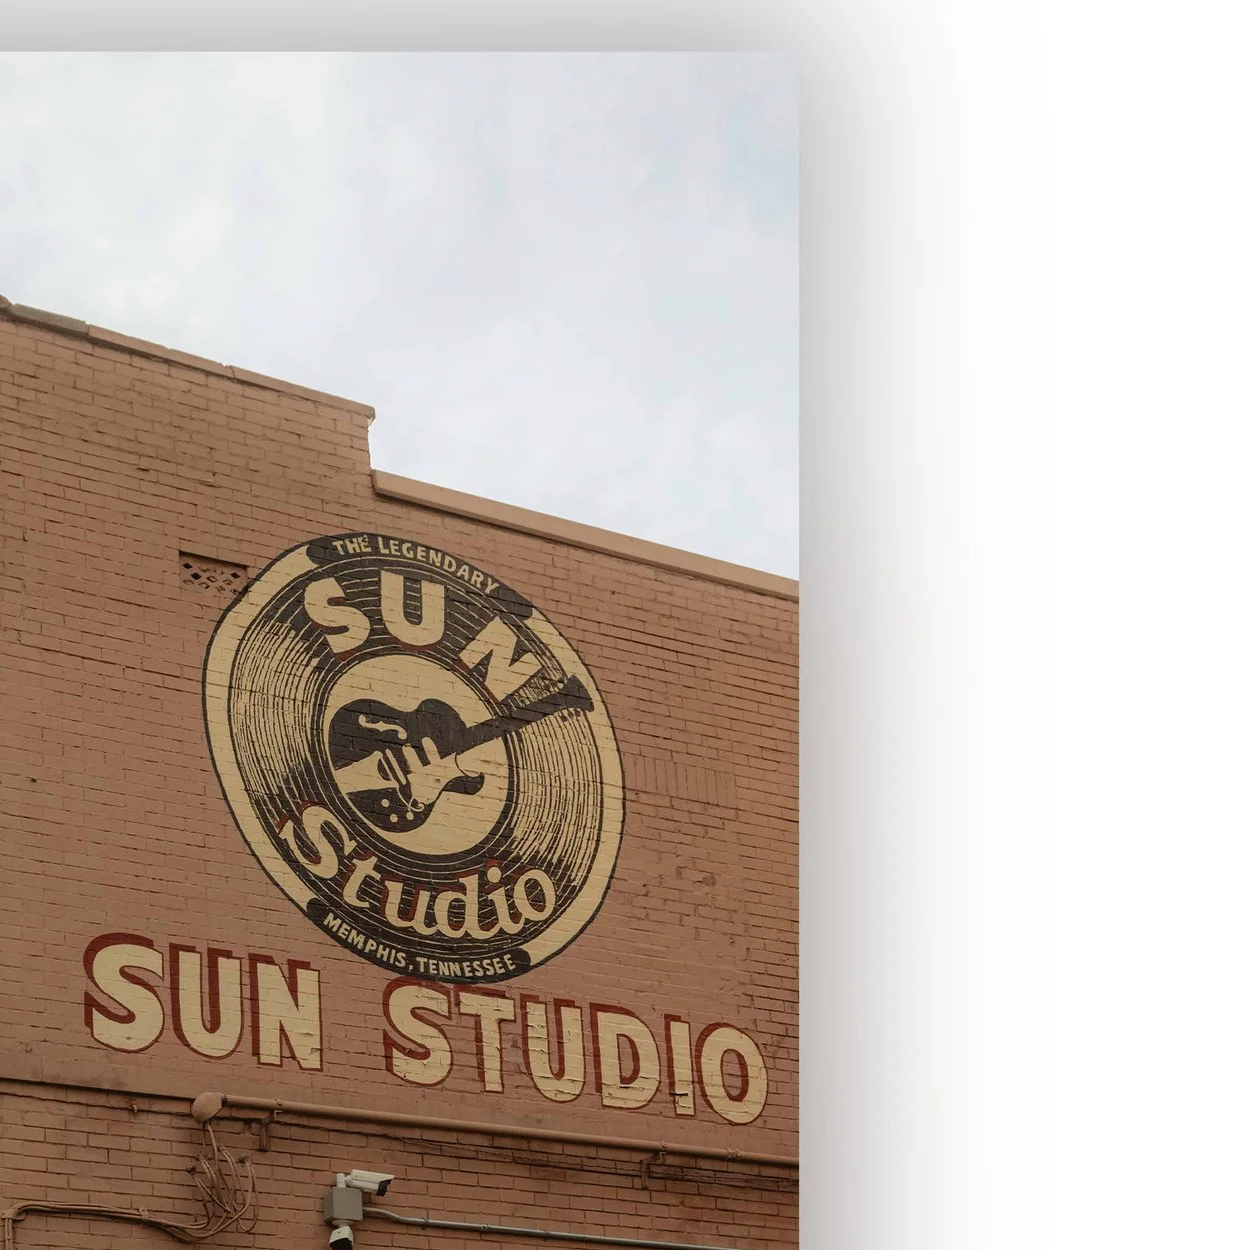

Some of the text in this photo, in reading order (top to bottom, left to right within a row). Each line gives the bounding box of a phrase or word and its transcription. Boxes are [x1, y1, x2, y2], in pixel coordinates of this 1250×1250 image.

[332, 534, 500, 594] THE LEGENDARY
[304, 570, 544, 702] SUN
[280, 802, 557, 939] Studio
[83, 933, 769, 1125] SUN STUDIO
[415, 953, 517, 978] TENNESSEE
